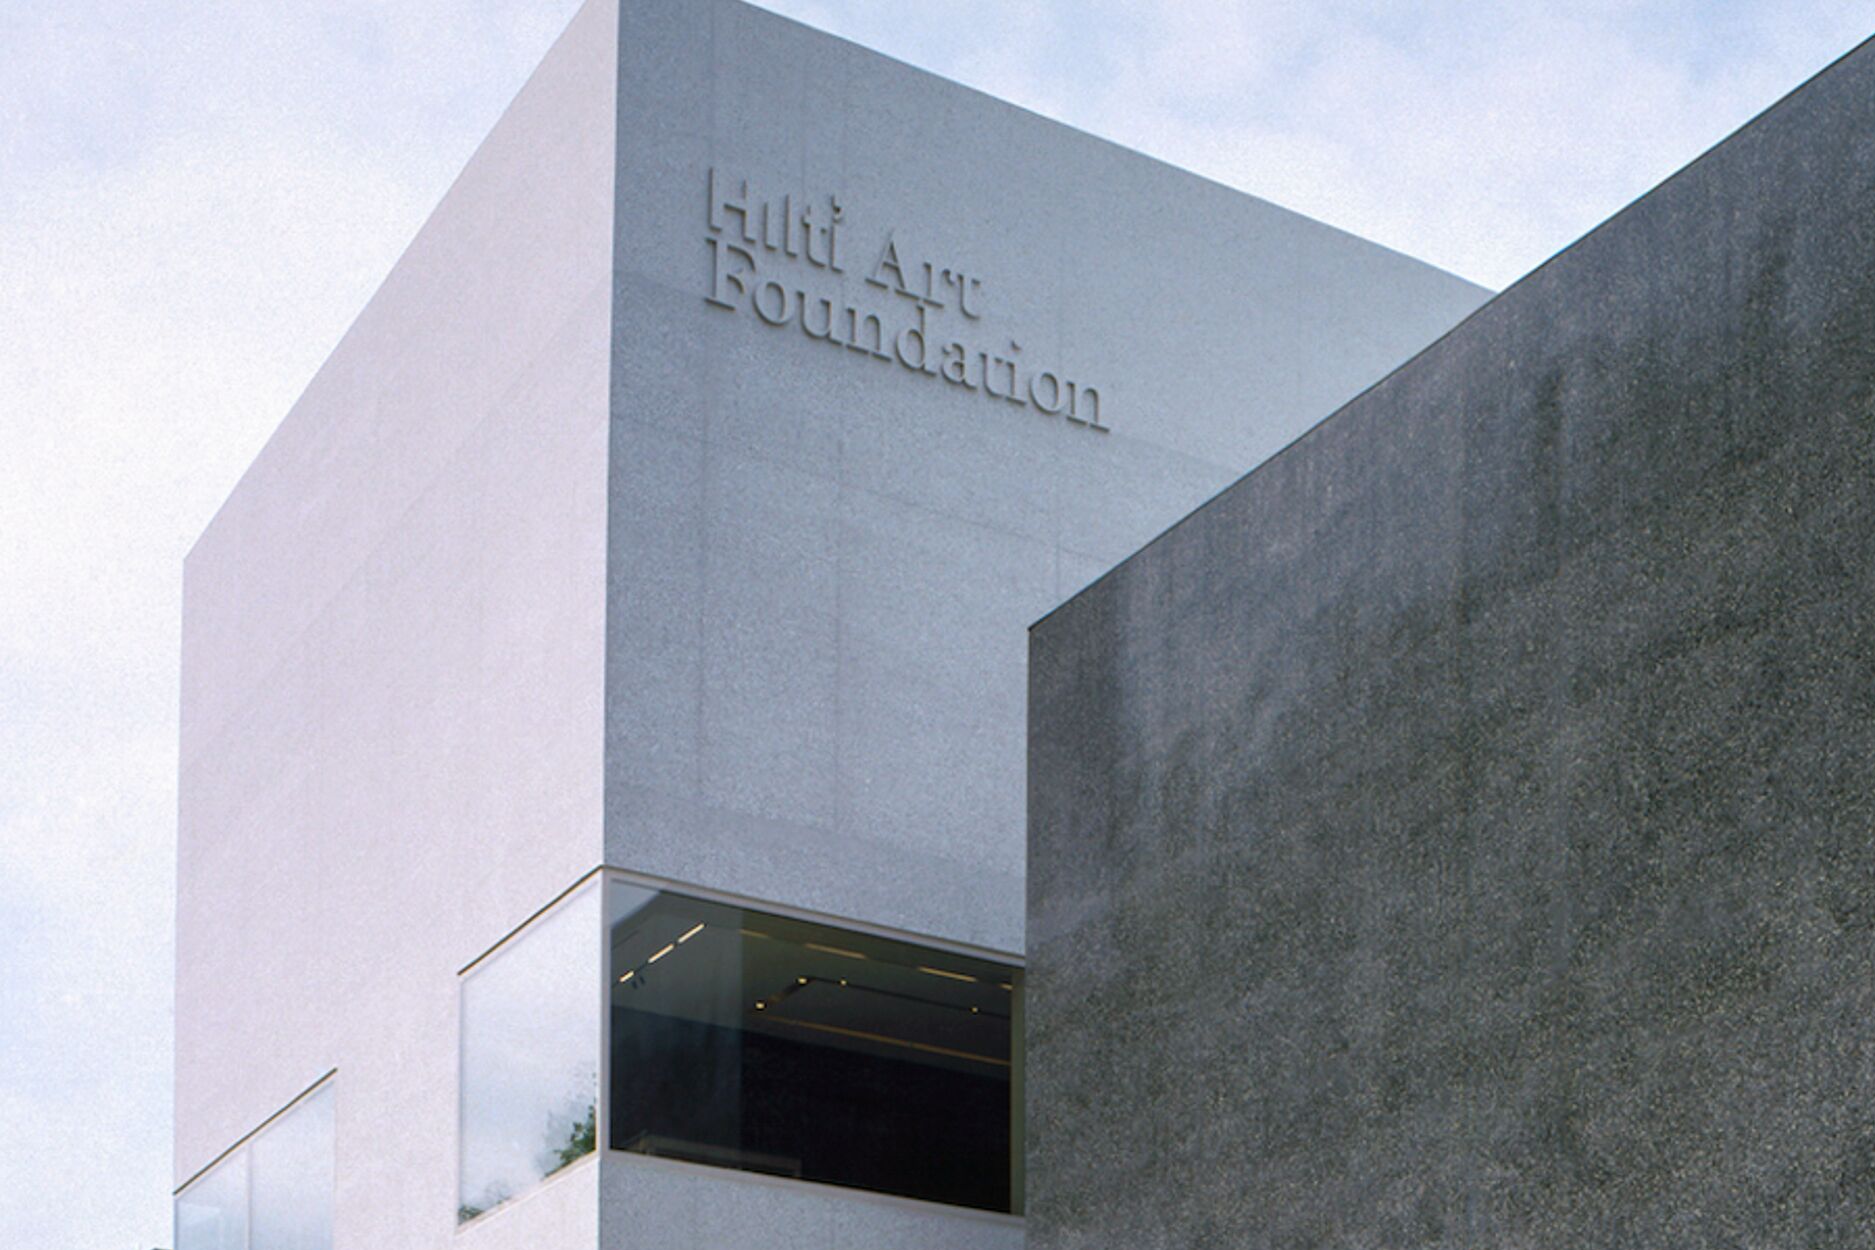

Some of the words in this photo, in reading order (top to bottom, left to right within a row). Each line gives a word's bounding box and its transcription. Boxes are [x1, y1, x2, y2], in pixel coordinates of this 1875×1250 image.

[707, 166, 844, 274] Hilti
[865, 228, 982, 321] Art
[703, 236, 1111, 434] Foundation
